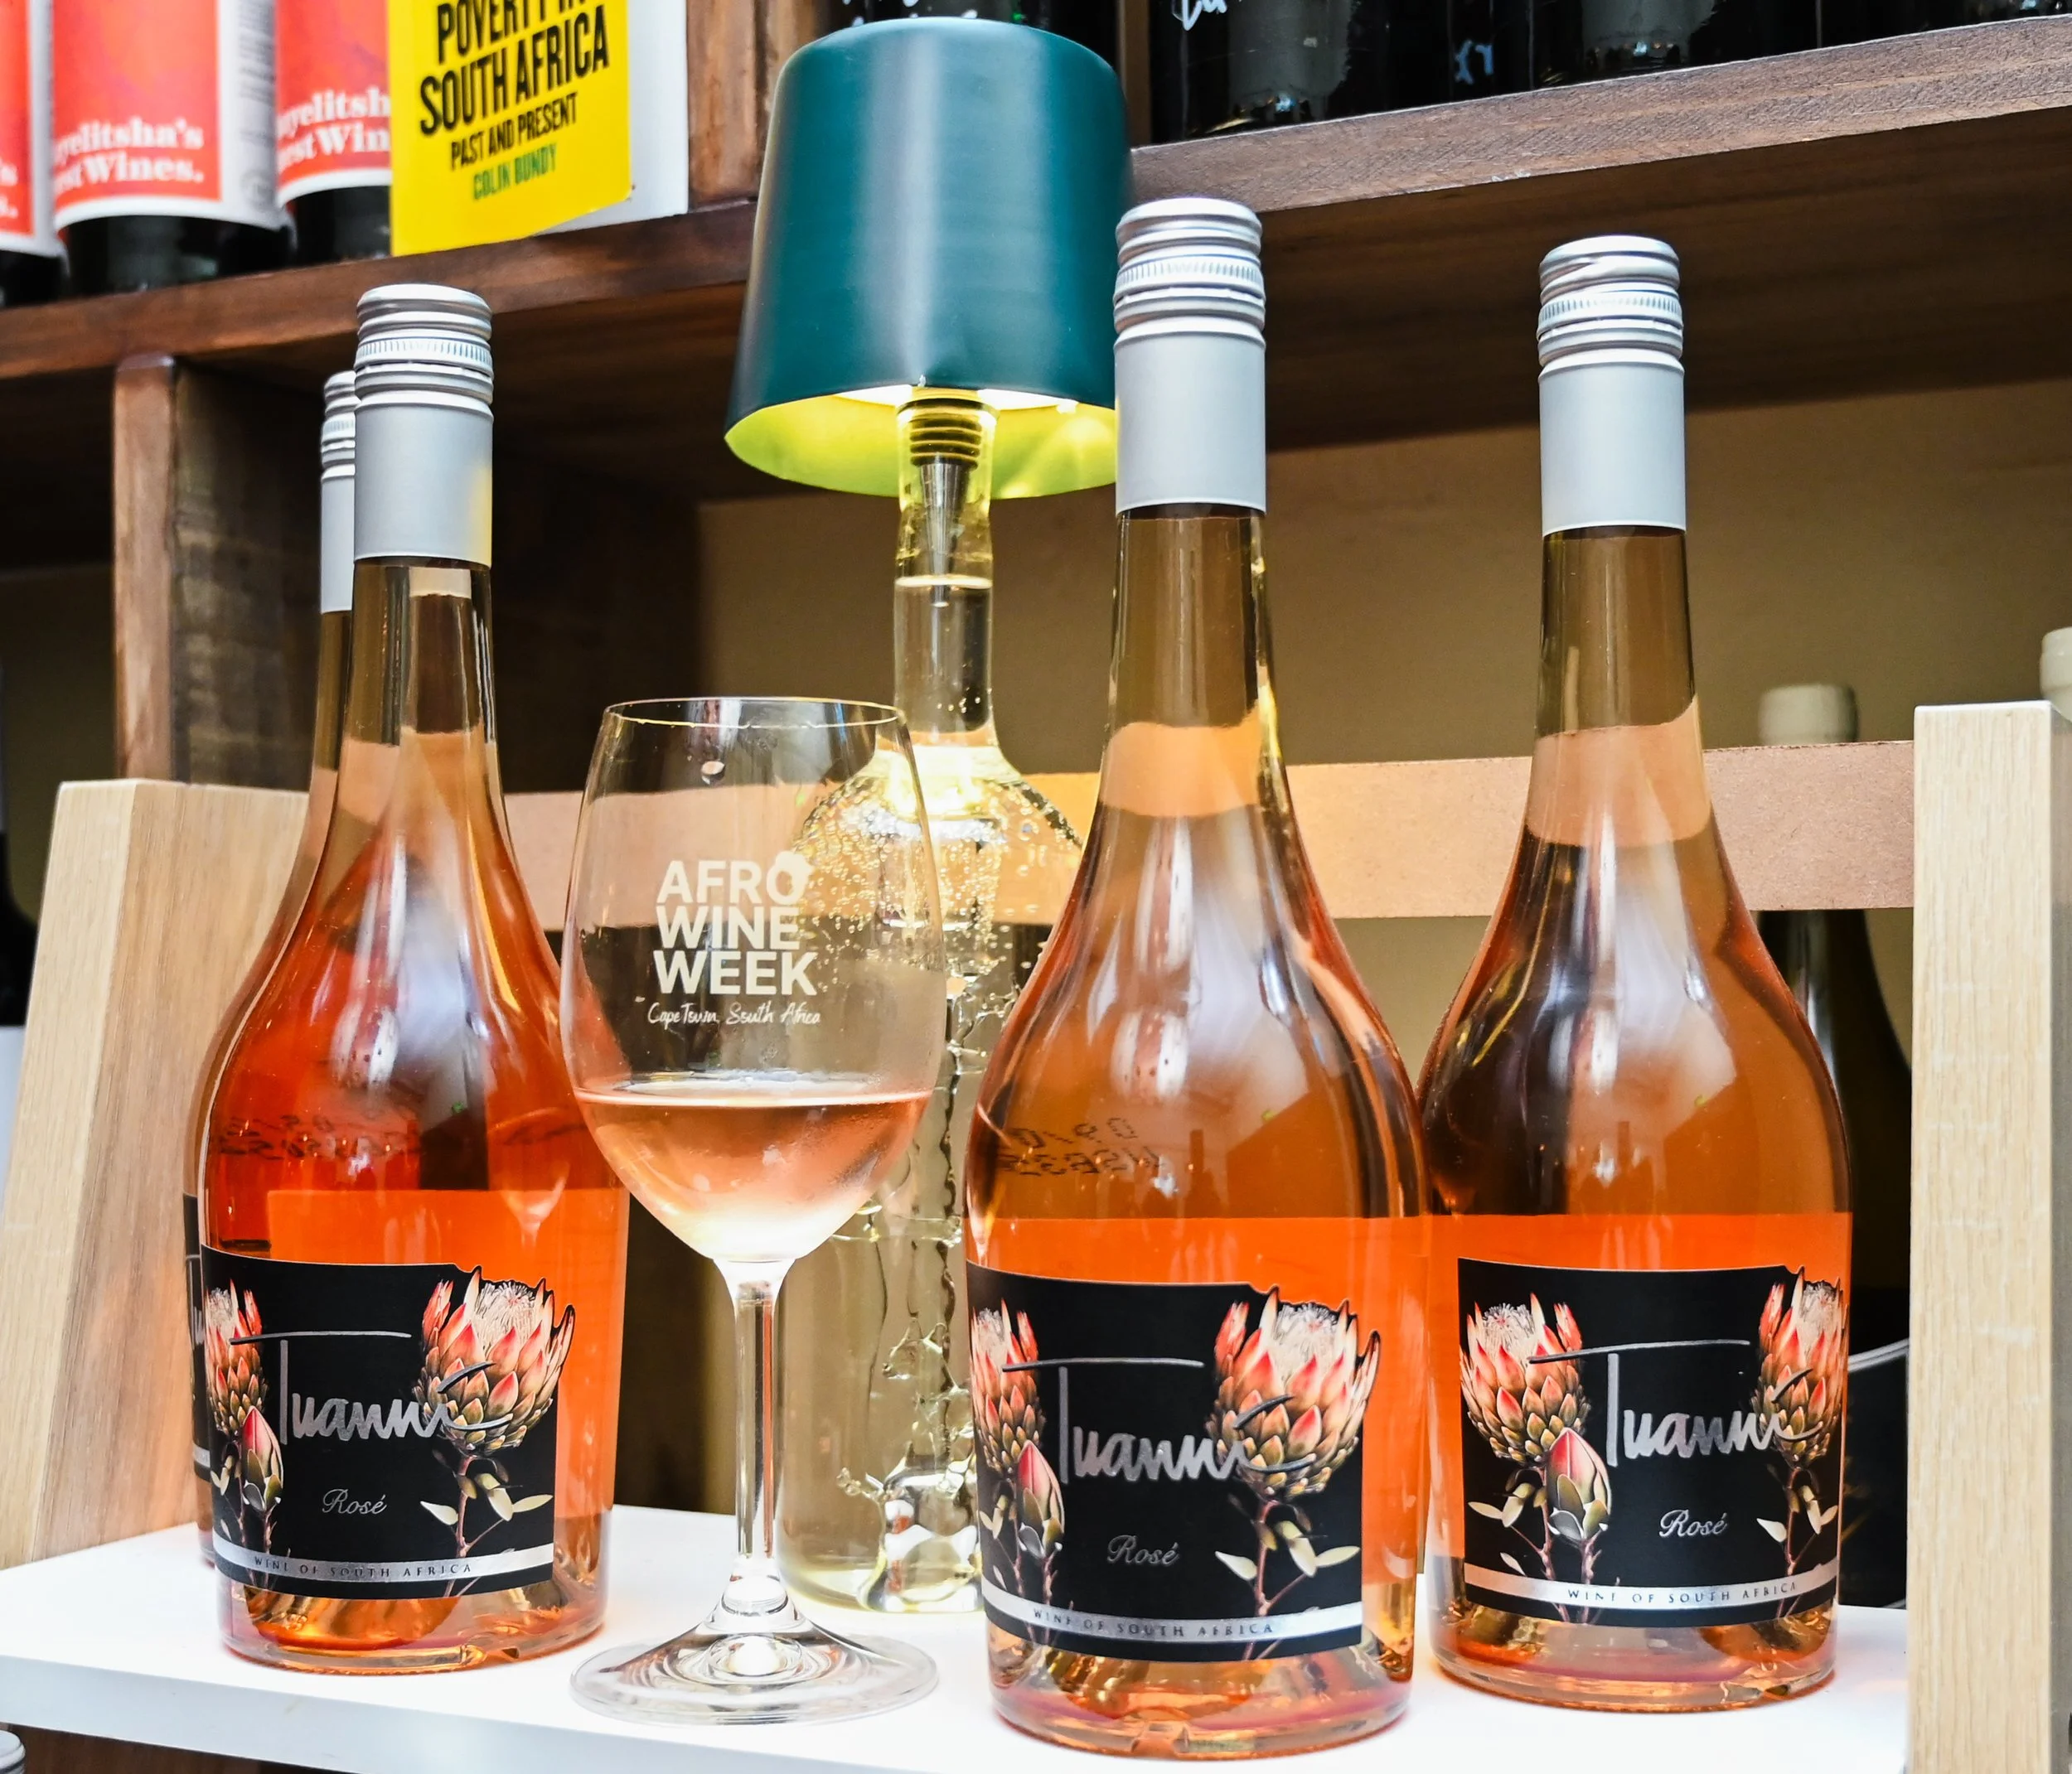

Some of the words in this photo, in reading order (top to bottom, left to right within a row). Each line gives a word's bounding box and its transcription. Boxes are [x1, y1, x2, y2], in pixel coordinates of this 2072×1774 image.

[419, 47, 509, 136] SOUTH
[516, 5, 610, 104] AFRICA
[451, 130, 485, 172] PAST
[488, 118, 515, 157] AND
[517, 91, 578, 146] PRESENT
[473, 162, 511, 201] COLIN
[514, 143, 557, 186] BUNDY
[656, 850, 815, 905] AFRO
[656, 906, 801, 950] WINE
[653, 950, 820, 995] WEEK
[647, 1003, 681, 1029] Cape
[726, 999, 774, 1024] South
[780, 1000, 821, 1024] Africa
[322, 1488, 387, 1515] Rosé
[1658, 1509, 1728, 1538] Rosé
[1106, 1535, 1180, 1567] Rosé
[300, 1564, 317, 1575] OF
[331, 1566, 390, 1578] SOUTH
[404, 1563, 471, 1578] AFRICA
[1633, 1593, 1654, 1604] OF
[1668, 1591, 1730, 1604] SOUTH
[1742, 1581, 1797, 1599] AFRICA
[1083, 1618, 1104, 1631] OF
[1119, 1623, 1184, 1638] SOUTH
[1198, 1622, 1274, 1637] AFRICA
